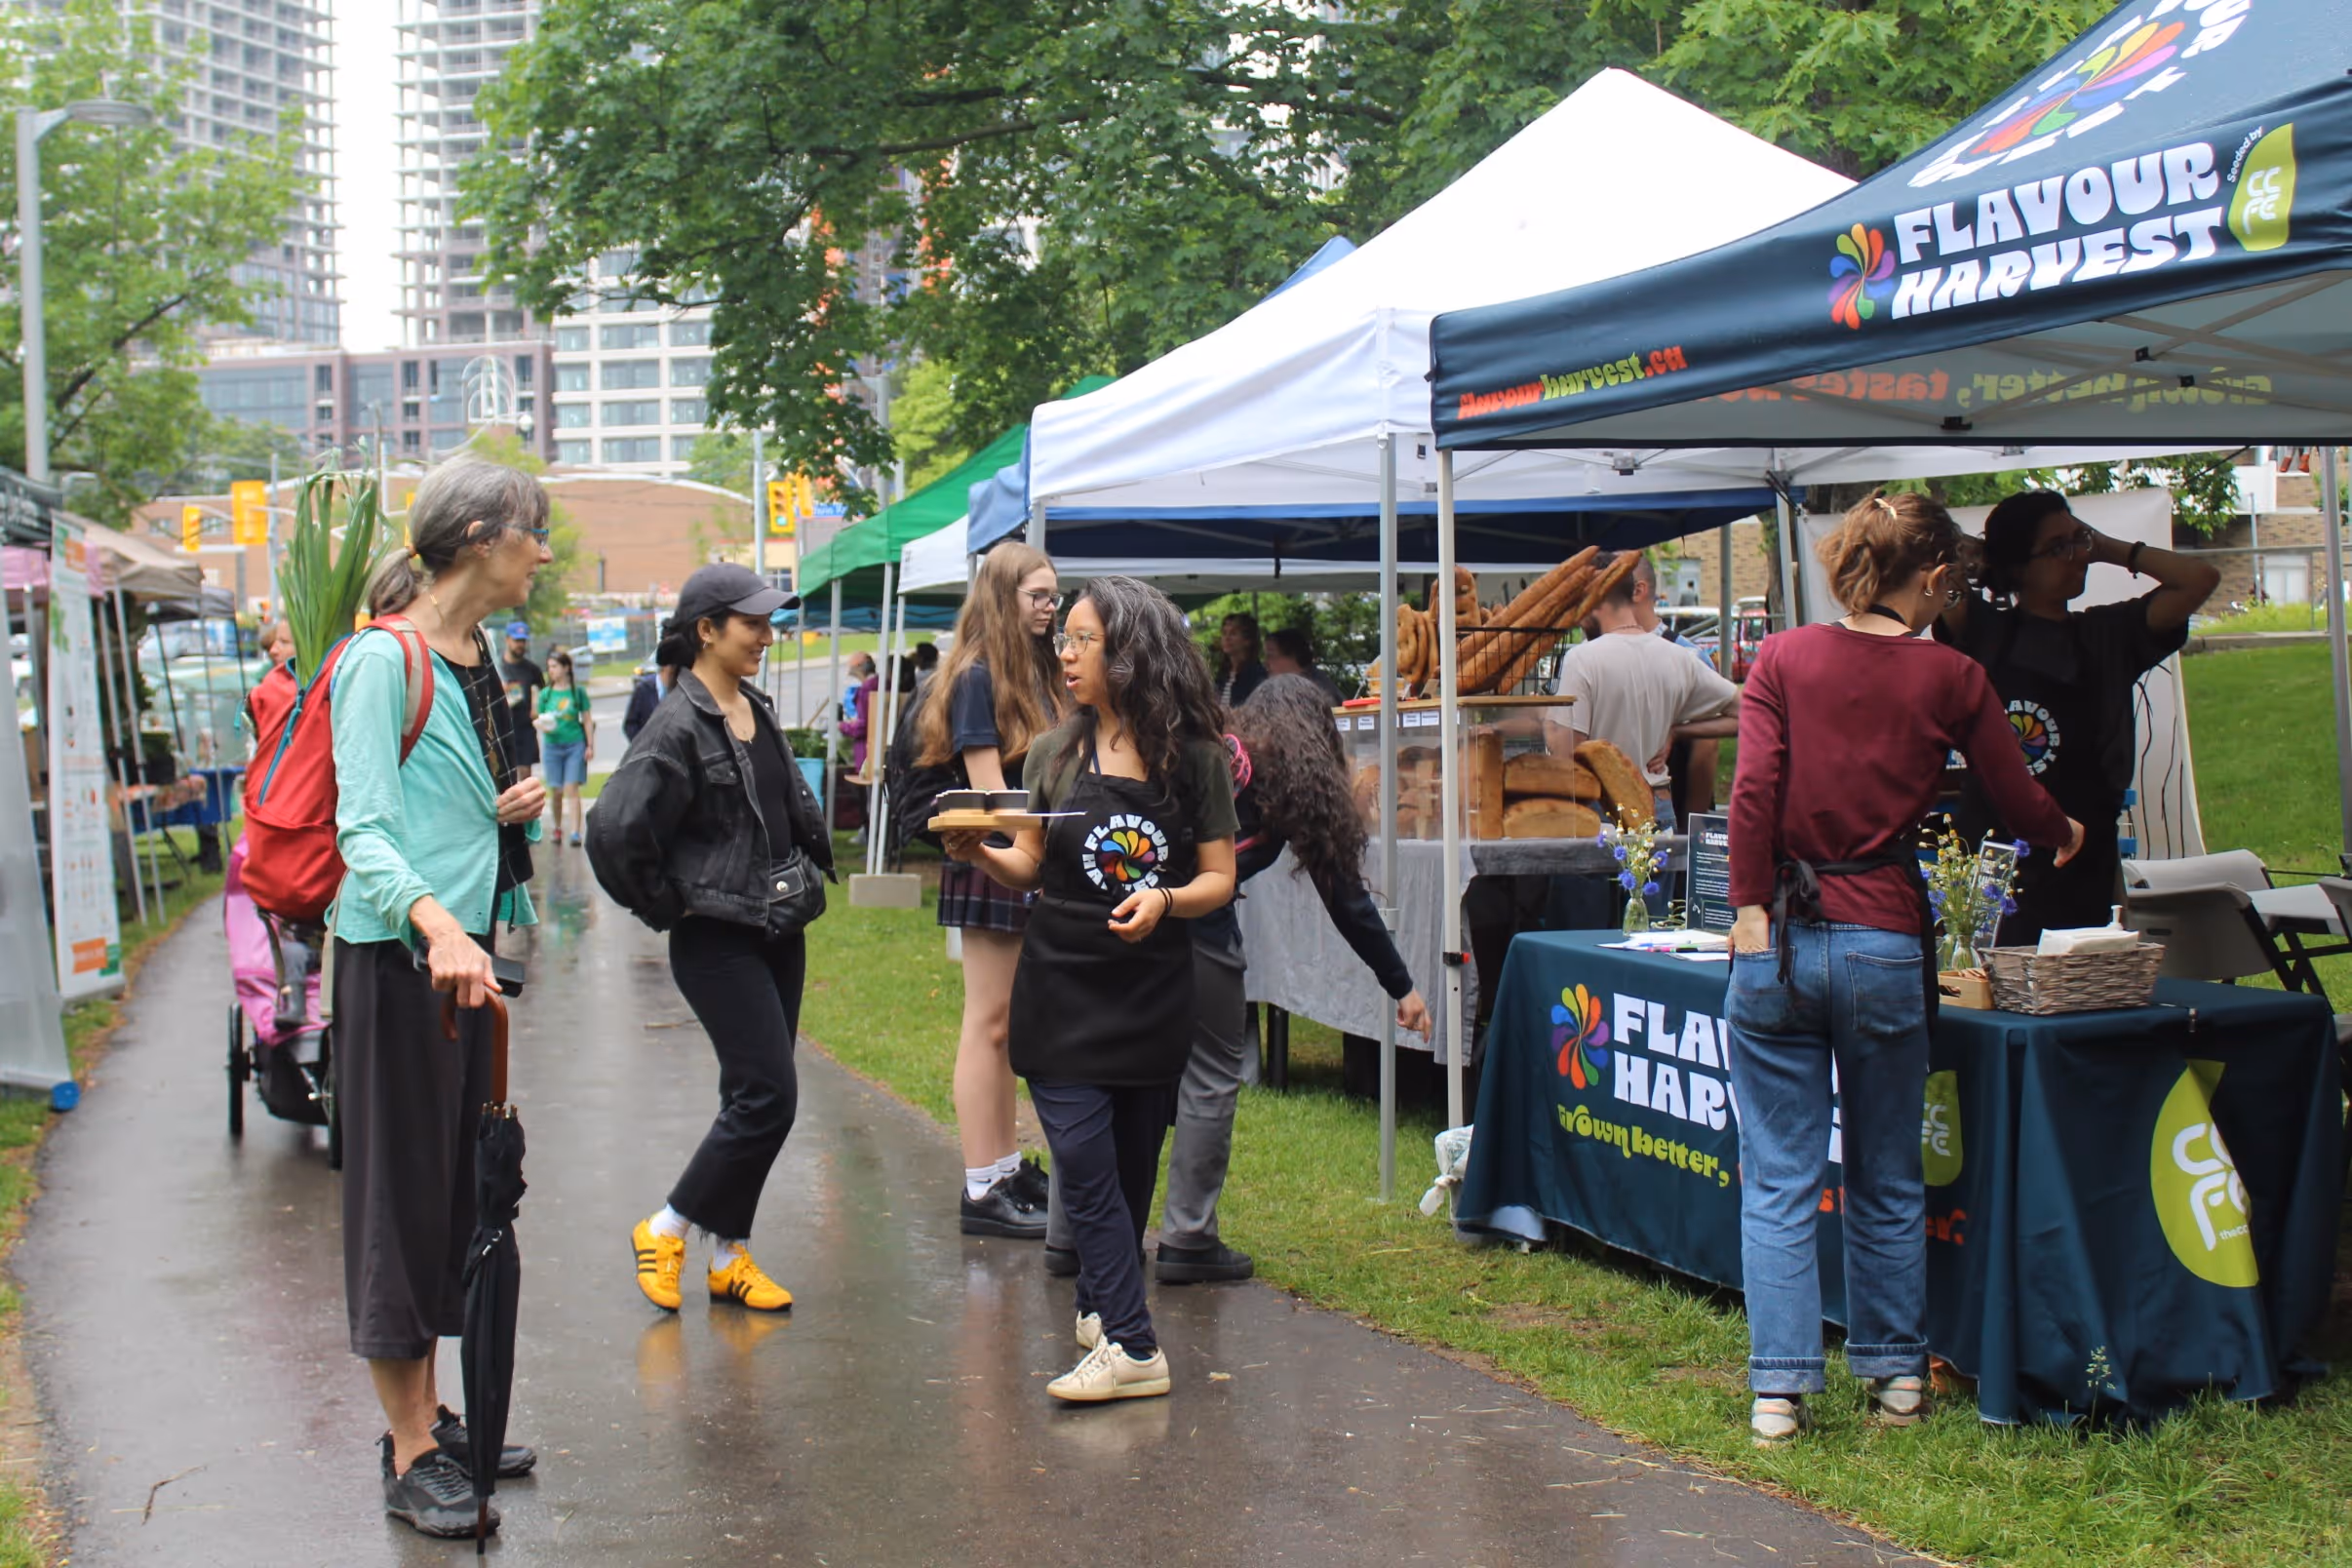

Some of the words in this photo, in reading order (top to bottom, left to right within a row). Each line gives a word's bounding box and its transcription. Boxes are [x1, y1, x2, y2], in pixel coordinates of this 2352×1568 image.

[2227, 137, 2252, 183] Seeded
[2249, 126, 2262, 141] by
[1895, 142, 2220, 264] FLAVOUR
[1892, 207, 2224, 320] HARVEST
[1457, 345, 1688, 419] flavourharvest.ca
[2005, 699, 2060, 747] AVOUR
[1084, 813, 1169, 862] FLAVOUR
[1081, 853, 1166, 892] HAEST
